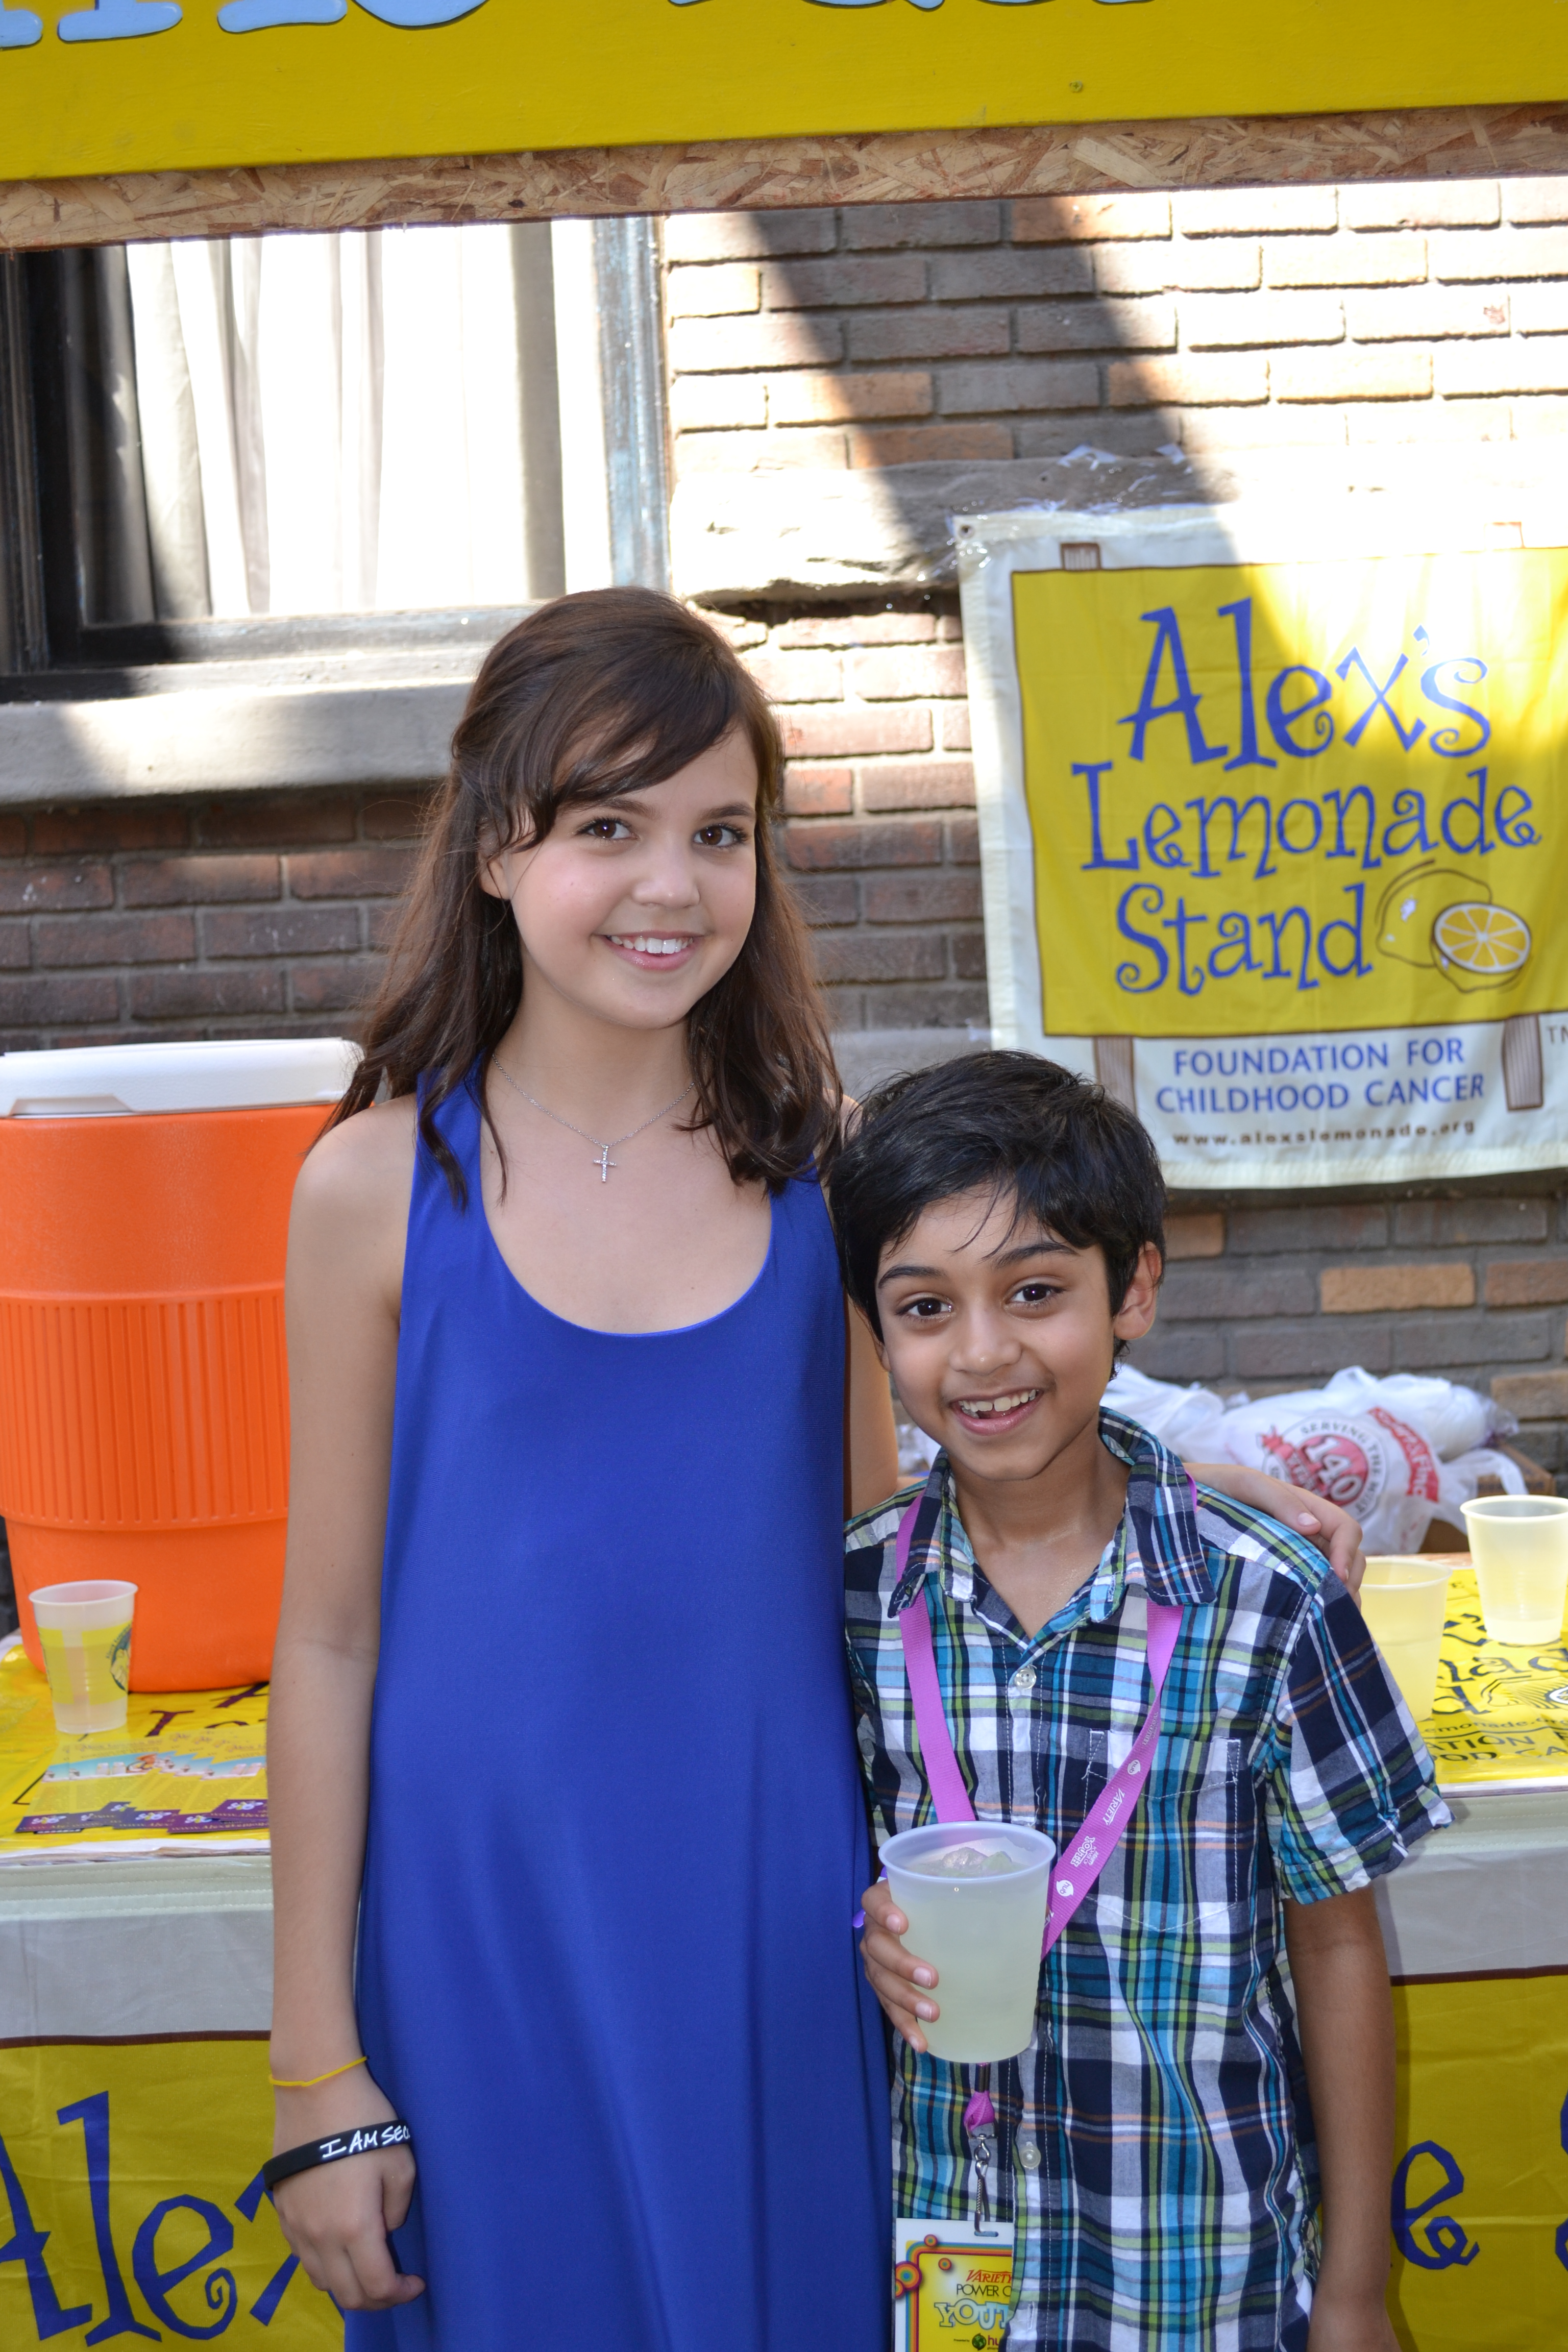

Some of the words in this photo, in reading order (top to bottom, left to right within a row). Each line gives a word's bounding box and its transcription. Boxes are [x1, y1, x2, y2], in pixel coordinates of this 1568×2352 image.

[1117, 597, 1490, 772] Alex's
[1071, 762, 1542, 880] Lemonade
[1115, 883, 1373, 995] Stand
[1173, 1041, 1388, 1076] FOUNDATION
[1407, 1037, 1464, 1066] FOR
[1156, 1083, 1349, 1114] CHILDHOOD
[1365, 1074, 1484, 1108] CANCER
[1304, 1437, 1362, 1501] 140
[1129, 1761, 1138, 1773] hub
[1102, 1788, 1125, 1826] VARIETY
[1070, 1835, 1095, 1867] YOUTH
[1060, 1882, 1071, 1895] hub
[320, 2138, 347, 2158] I
[349, 2129, 378, 2153] AM
[957, 2284, 999, 2297] POWER
[934, 2298, 1009, 2330] YOUT
[988, 2335, 999, 2345] hu
